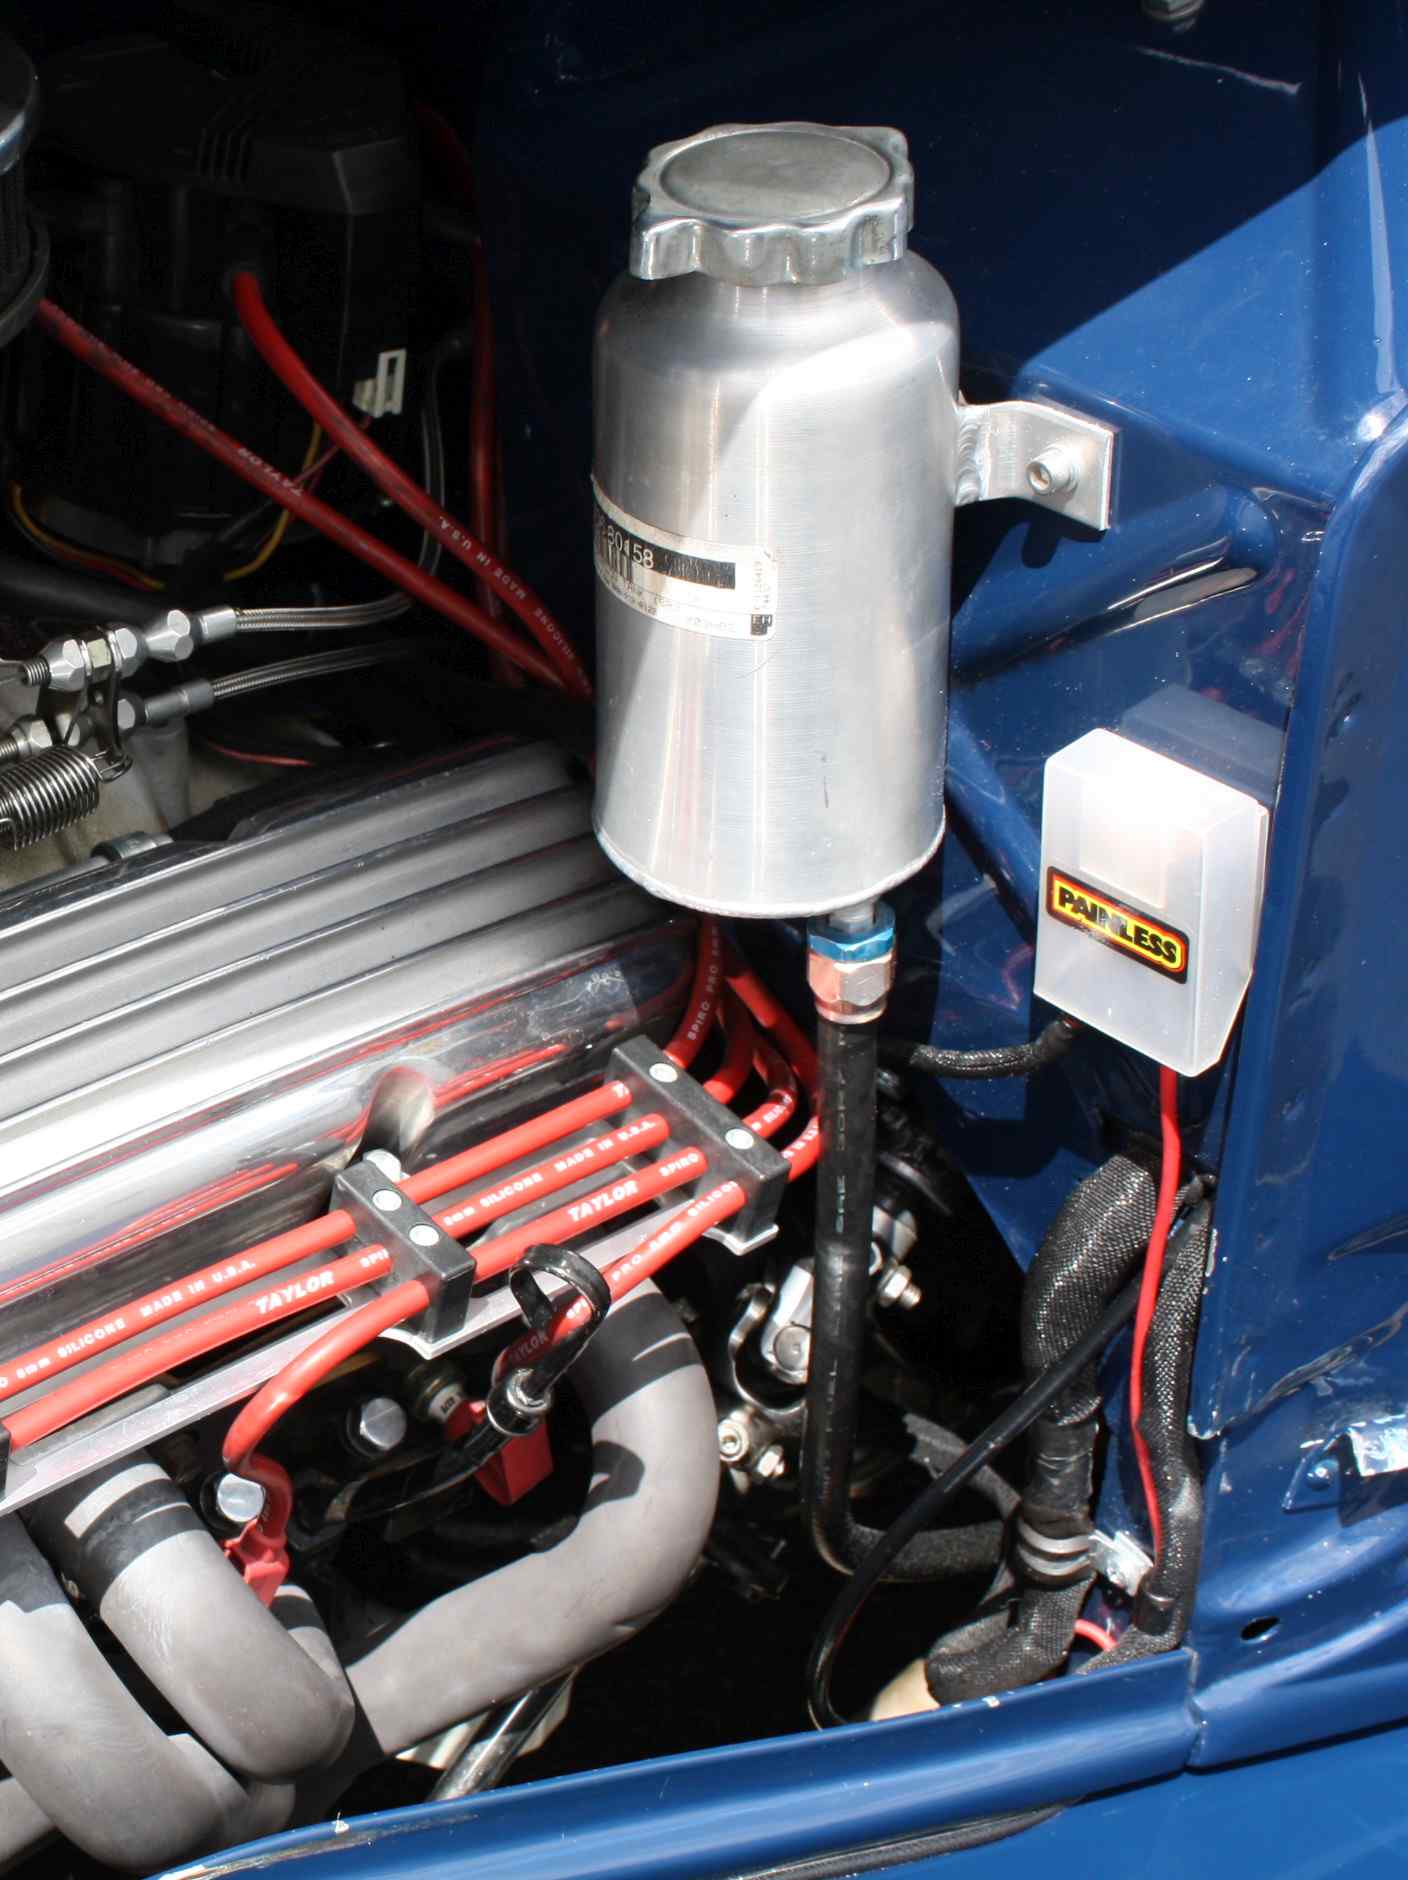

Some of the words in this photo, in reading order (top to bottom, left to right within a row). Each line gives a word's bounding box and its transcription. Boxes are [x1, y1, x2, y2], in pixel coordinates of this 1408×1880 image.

[476, 552, 490, 566] IN
[688, 1000, 711, 1041] SPIRO
[479, 1171, 543, 1208] SILICONE
[554, 1147, 595, 1173] MADE
[597, 1138, 614, 1152] IN
[567, 1179, 639, 1222] TAYLOR
[658, 1151, 699, 1177] SPIRO
[612, 1254, 643, 1282] PRO
[56, 1316, 127, 1359] SILICONE
[139, 1288, 185, 1319] MADE
[190, 1279, 206, 1295] IN
[211, 1257, 257, 1284] U.S.A.
[254, 1269, 336, 1315] TAYLOR
